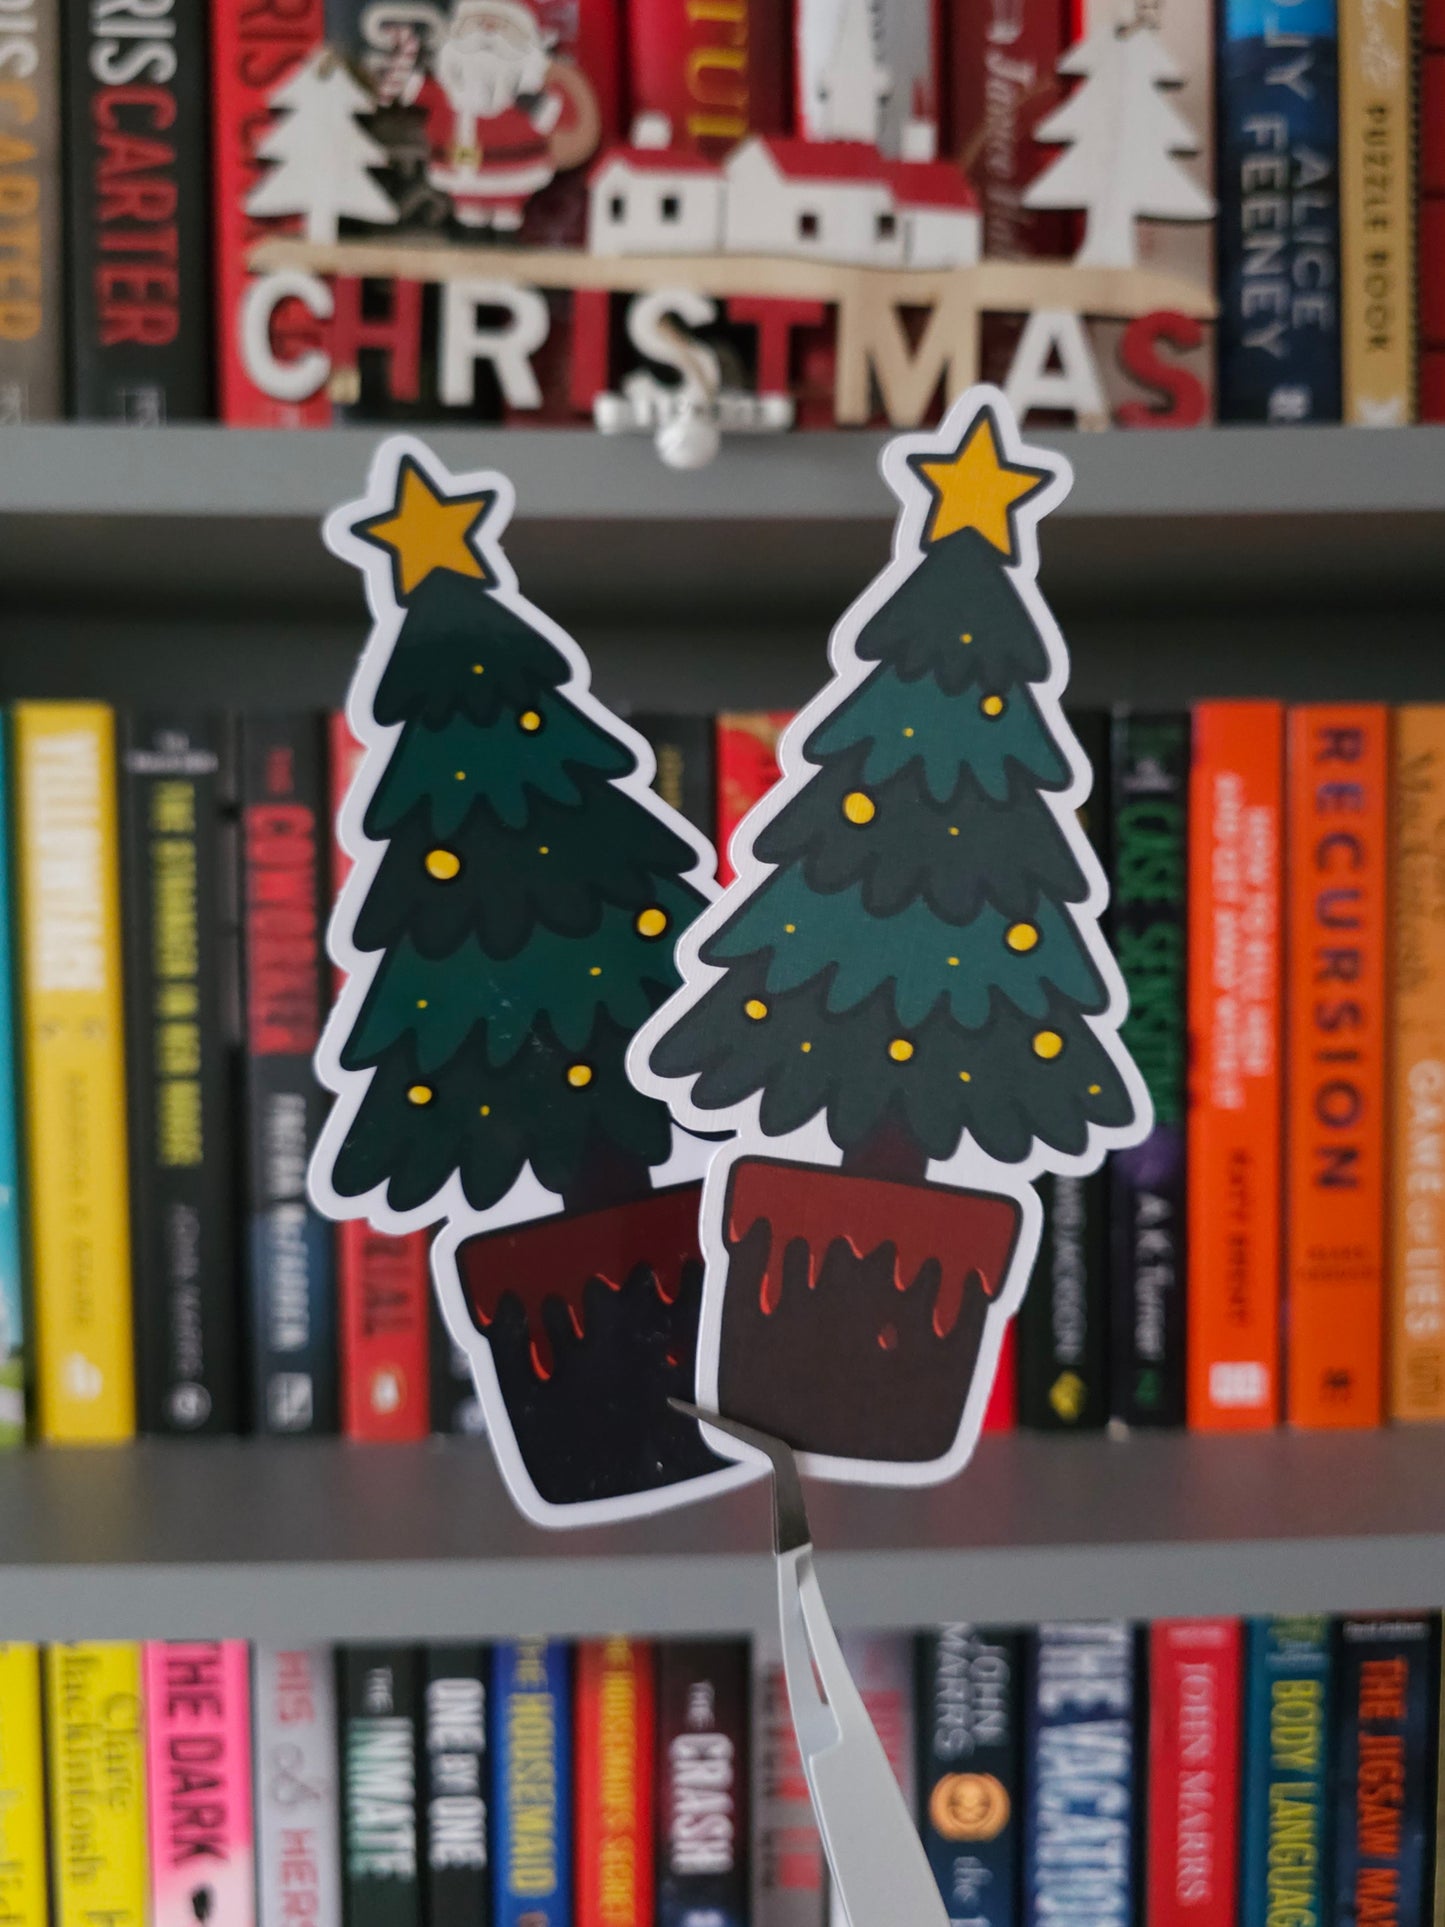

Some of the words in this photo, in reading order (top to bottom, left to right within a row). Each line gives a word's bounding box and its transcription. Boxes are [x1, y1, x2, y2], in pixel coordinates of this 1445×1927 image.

[94, 84, 180, 345] CARTER
[1361, 103, 1391, 230] PUZZLE
[1241, 113, 1289, 360] FEENEY
[1287, 140, 1334, 333] ALICE
[238, 270, 1210, 428] CHRISTMAS
[1361, 248, 1391, 354] BOOK
[1117, 801, 1182, 904] CASE
[1315, 726, 1366, 1190] RECURSION
[1407, 1059, 1444, 1191] GAME
[1405, 1246, 1444, 1340] LIES
[276, 1650, 316, 1724] HIS
[426, 1677, 487, 1753] ONE
[970, 1643, 1011, 1747] JOHN
[1037, 1621, 1133, 1717] THE
[1176, 1662, 1217, 1767] JOHN
[1270, 1680, 1323, 1770] BODY
[1358, 1655, 1409, 1721] THE
[102, 1691, 140, 1813] Clare
[168, 1734, 230, 1868] DARK
[347, 1716, 416, 1878] INMATE
[431, 1753, 479, 1795] BY
[508, 1691, 556, 1893] HOUSEMAID
[669, 1731, 735, 1874] CRASH
[1356, 1732, 1407, 1859] JIGSAW
[428, 1795, 489, 1871] ONE
[1175, 1770, 1216, 1907] MARRS
